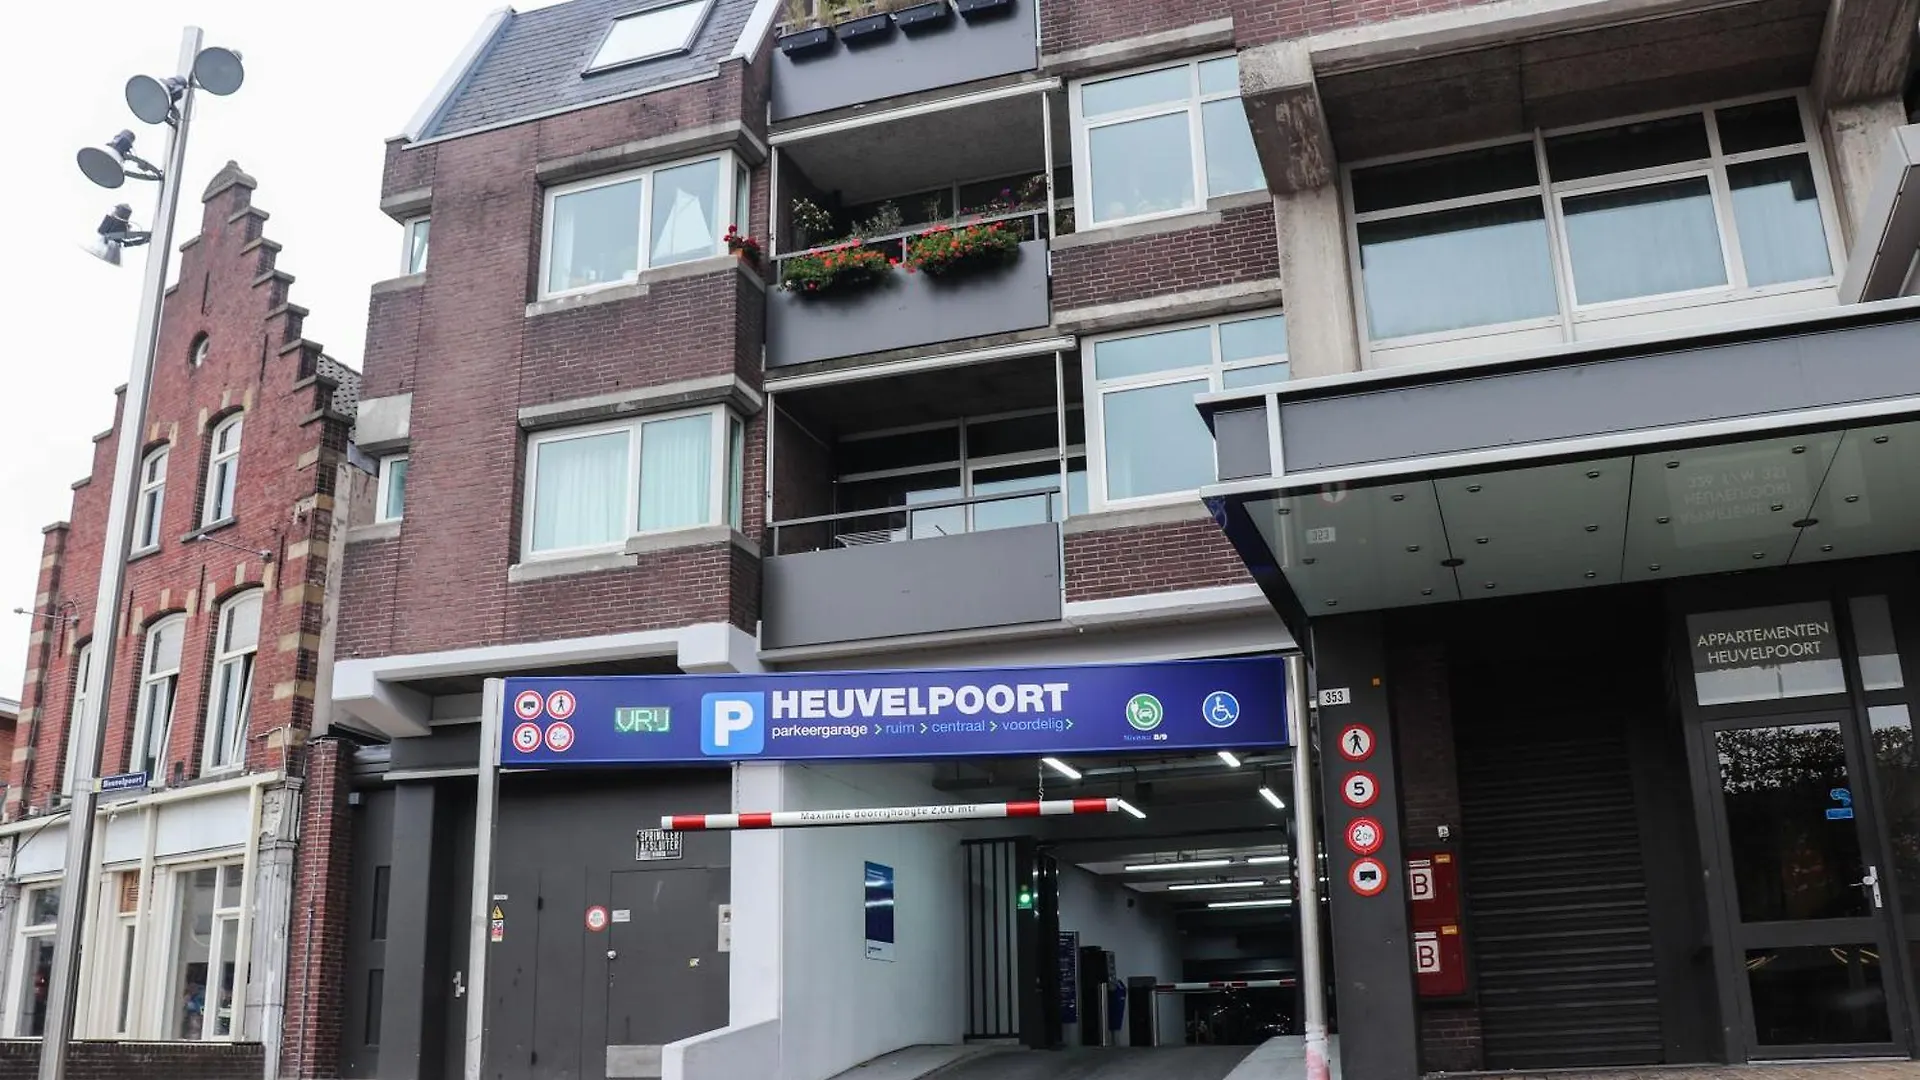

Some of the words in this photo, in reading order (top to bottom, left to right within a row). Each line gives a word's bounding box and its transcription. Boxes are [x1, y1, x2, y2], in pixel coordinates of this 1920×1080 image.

[1697, 621, 1829, 648] APPARTEMENTEN
[1707, 640, 1822, 665] HEUVELPOORT
[772, 682, 1069, 719] HEUVELPOORT
[1325, 690, 1344, 704] 353
[617, 710, 669, 731] VRIJ
[714, 699, 754, 747] P
[771, 723, 868, 740] parkeergarage
[885, 721, 915, 735] ruim
[932, 719, 986, 733] centraal
[1002, 717, 1063, 733] voordelig
[523, 730, 532, 744] 5
[1353, 781, 1366, 797] 5
[1412, 873, 1429, 897] B
[1419, 945, 1436, 969] B
